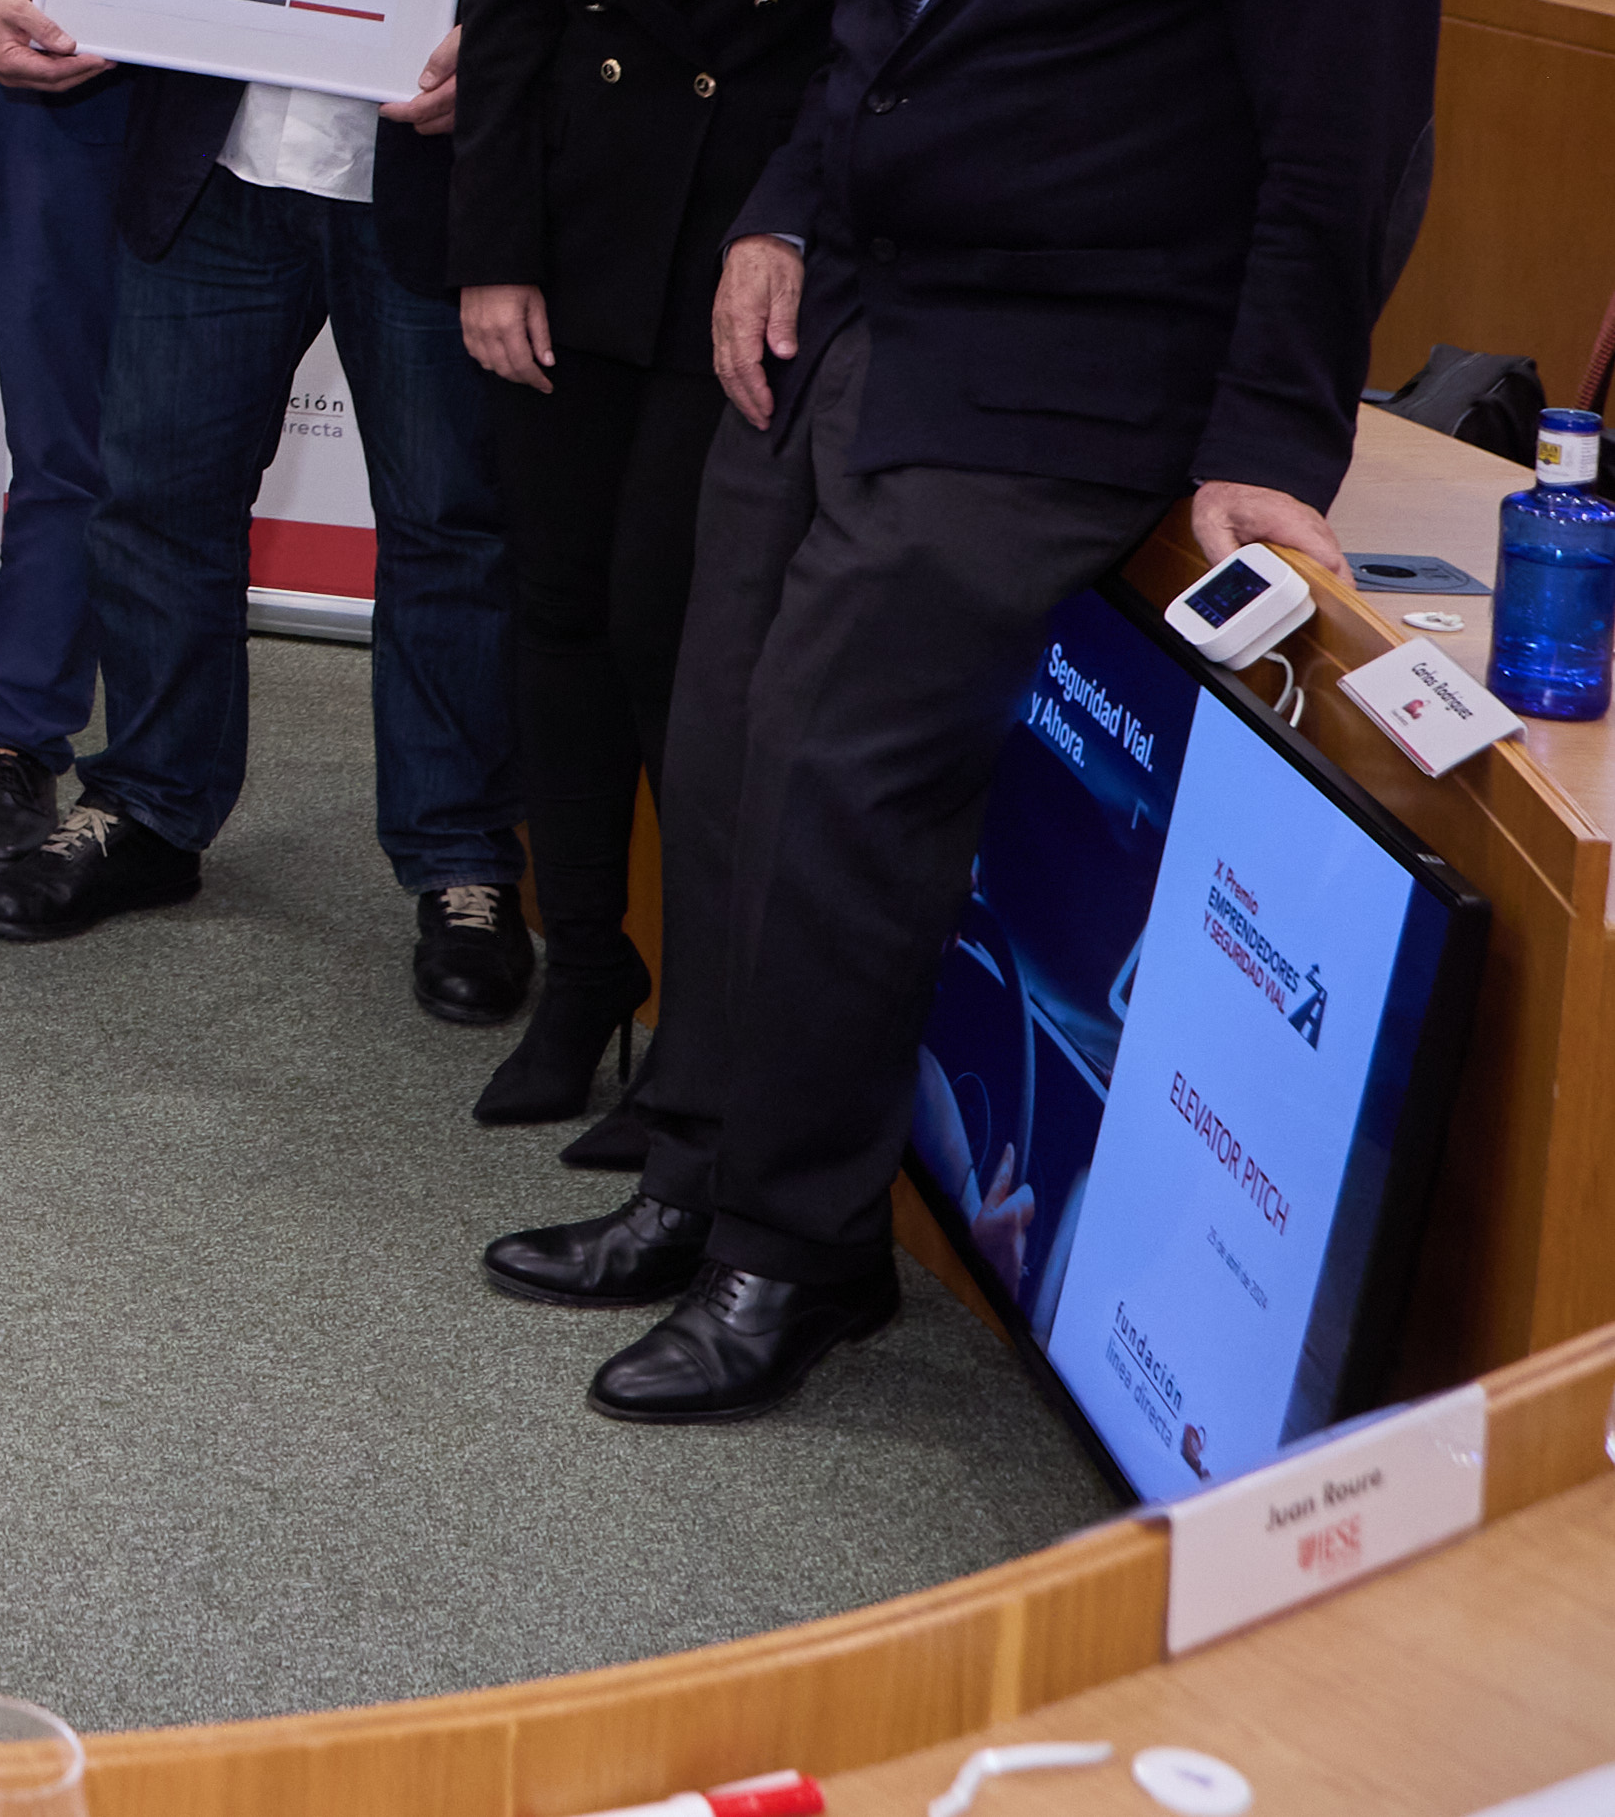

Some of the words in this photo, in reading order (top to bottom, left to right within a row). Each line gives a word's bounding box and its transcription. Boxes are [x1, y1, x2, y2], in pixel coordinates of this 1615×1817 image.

[1048, 643, 1123, 737] Seguridad
[1123, 711, 1154, 772] Vial.
[1412, 662, 1438, 686] Carlos
[1028, 692, 1042, 725] y
[1040, 698, 1085, 768] Ahora.
[1214, 858, 1224, 879] X
[1224, 867, 1259, 916] Premio
[1204, 910, 1211, 931] Y
[1210, 919, 1264, 988] SEGURIDAD
[1265, 974, 1287, 1014] VIAL
[1208, 885, 1300, 994] EMPRENDEDORES
[1170, 1071, 1242, 1180] ELEVATOR
[1241, 1156, 1290, 1236] PITCH
[1115, 1301, 1182, 1411] fundación
[1265, 1496, 1315, 1532] Juan
